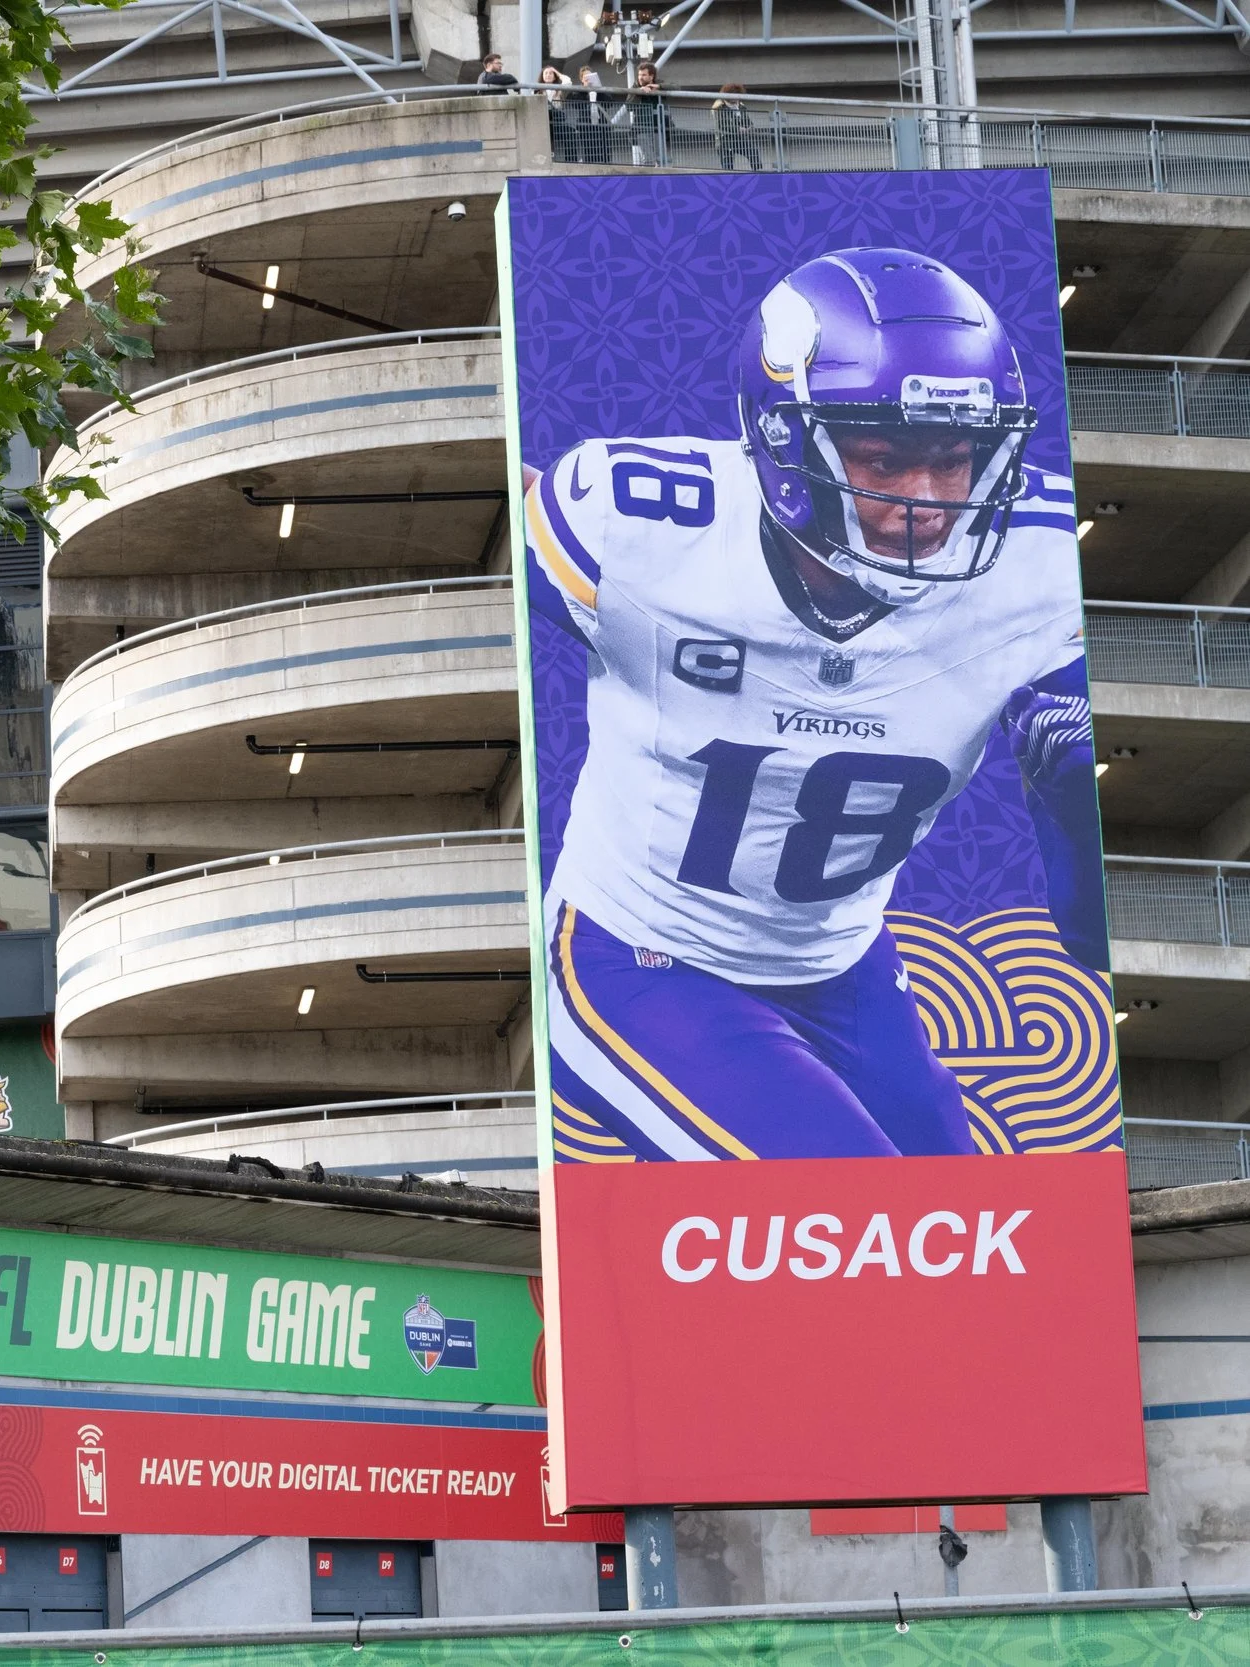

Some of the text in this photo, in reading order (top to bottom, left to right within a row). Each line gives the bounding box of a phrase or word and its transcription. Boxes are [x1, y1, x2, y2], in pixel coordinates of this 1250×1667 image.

[605, 443, 715, 528] 18
[821, 668, 850, 683] NFL
[772, 709, 886, 740] VIKINGS
[676, 738, 951, 904] 18
[661, 1209, 1034, 1283] CUSACK
[56, 1260, 228, 1359] DUBLIN
[246, 1277, 376, 1370] GAME
[409, 1331, 441, 1342] DUBLIN
[140, 1457, 516, 1497] HAVE YOUR DIGITAL TICKET READY
[62, 1556, 75, 1567] D7
[319, 1560, 330, 1570] D8
[381, 1560, 392, 1570] D9
[601, 1563, 614, 1572] D10
